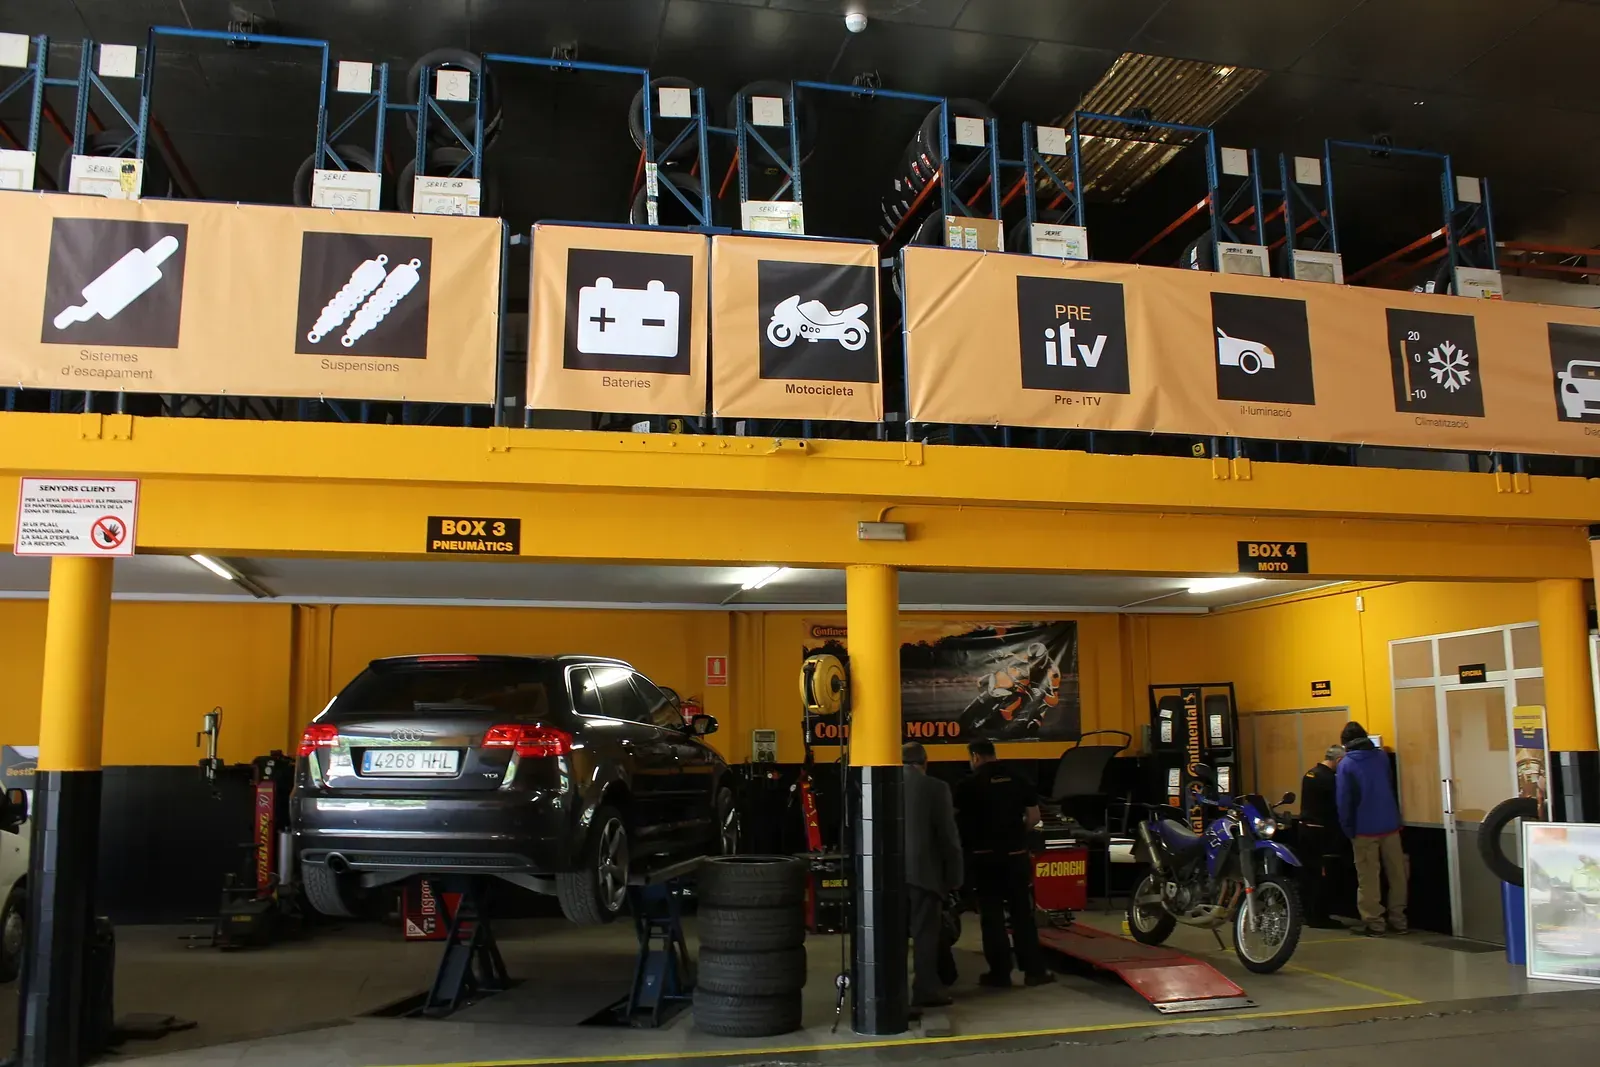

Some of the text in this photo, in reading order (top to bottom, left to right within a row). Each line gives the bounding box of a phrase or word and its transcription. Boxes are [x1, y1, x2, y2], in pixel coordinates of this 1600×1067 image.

[322, 173, 348, 181] SERIE
[424, 181, 449, 189] SERIE
[1055, 304, 1092, 321] PRE
[1407, 331, 1420, 341] 20
[1044, 322, 1107, 368] itv
[80, 349, 139, 363] Sistemes
[1414, 353, 1421, 363] 0
[320, 358, 400, 373] Suspensions
[61, 365, 153, 380] d'escapament
[602, 376, 651, 389] Bateries
[785, 383, 854, 396] Motocicleta
[1410, 389, 1427, 399] -10
[1054, 394, 1073, 405] Pre
[1082, 396, 1101, 406] ITV
[1584, 426, 1600, 439] Diag
[39, 484, 116, 493] SENYORS CLIENTS
[441, 519, 506, 537] BOX 3
[432, 538, 514, 552] PNEUMÀTICS
[1248, 543, 1297, 558] BOX 4
[1258, 562, 1289, 571] MOTO
[813, 626, 848, 637] Contine
[815, 721, 961, 739] Con MOTO
[374, 752, 453, 769] 4268 HHL
[6, 767, 36, 776] BestD
[1050, 860, 1085, 876] CORGHI
